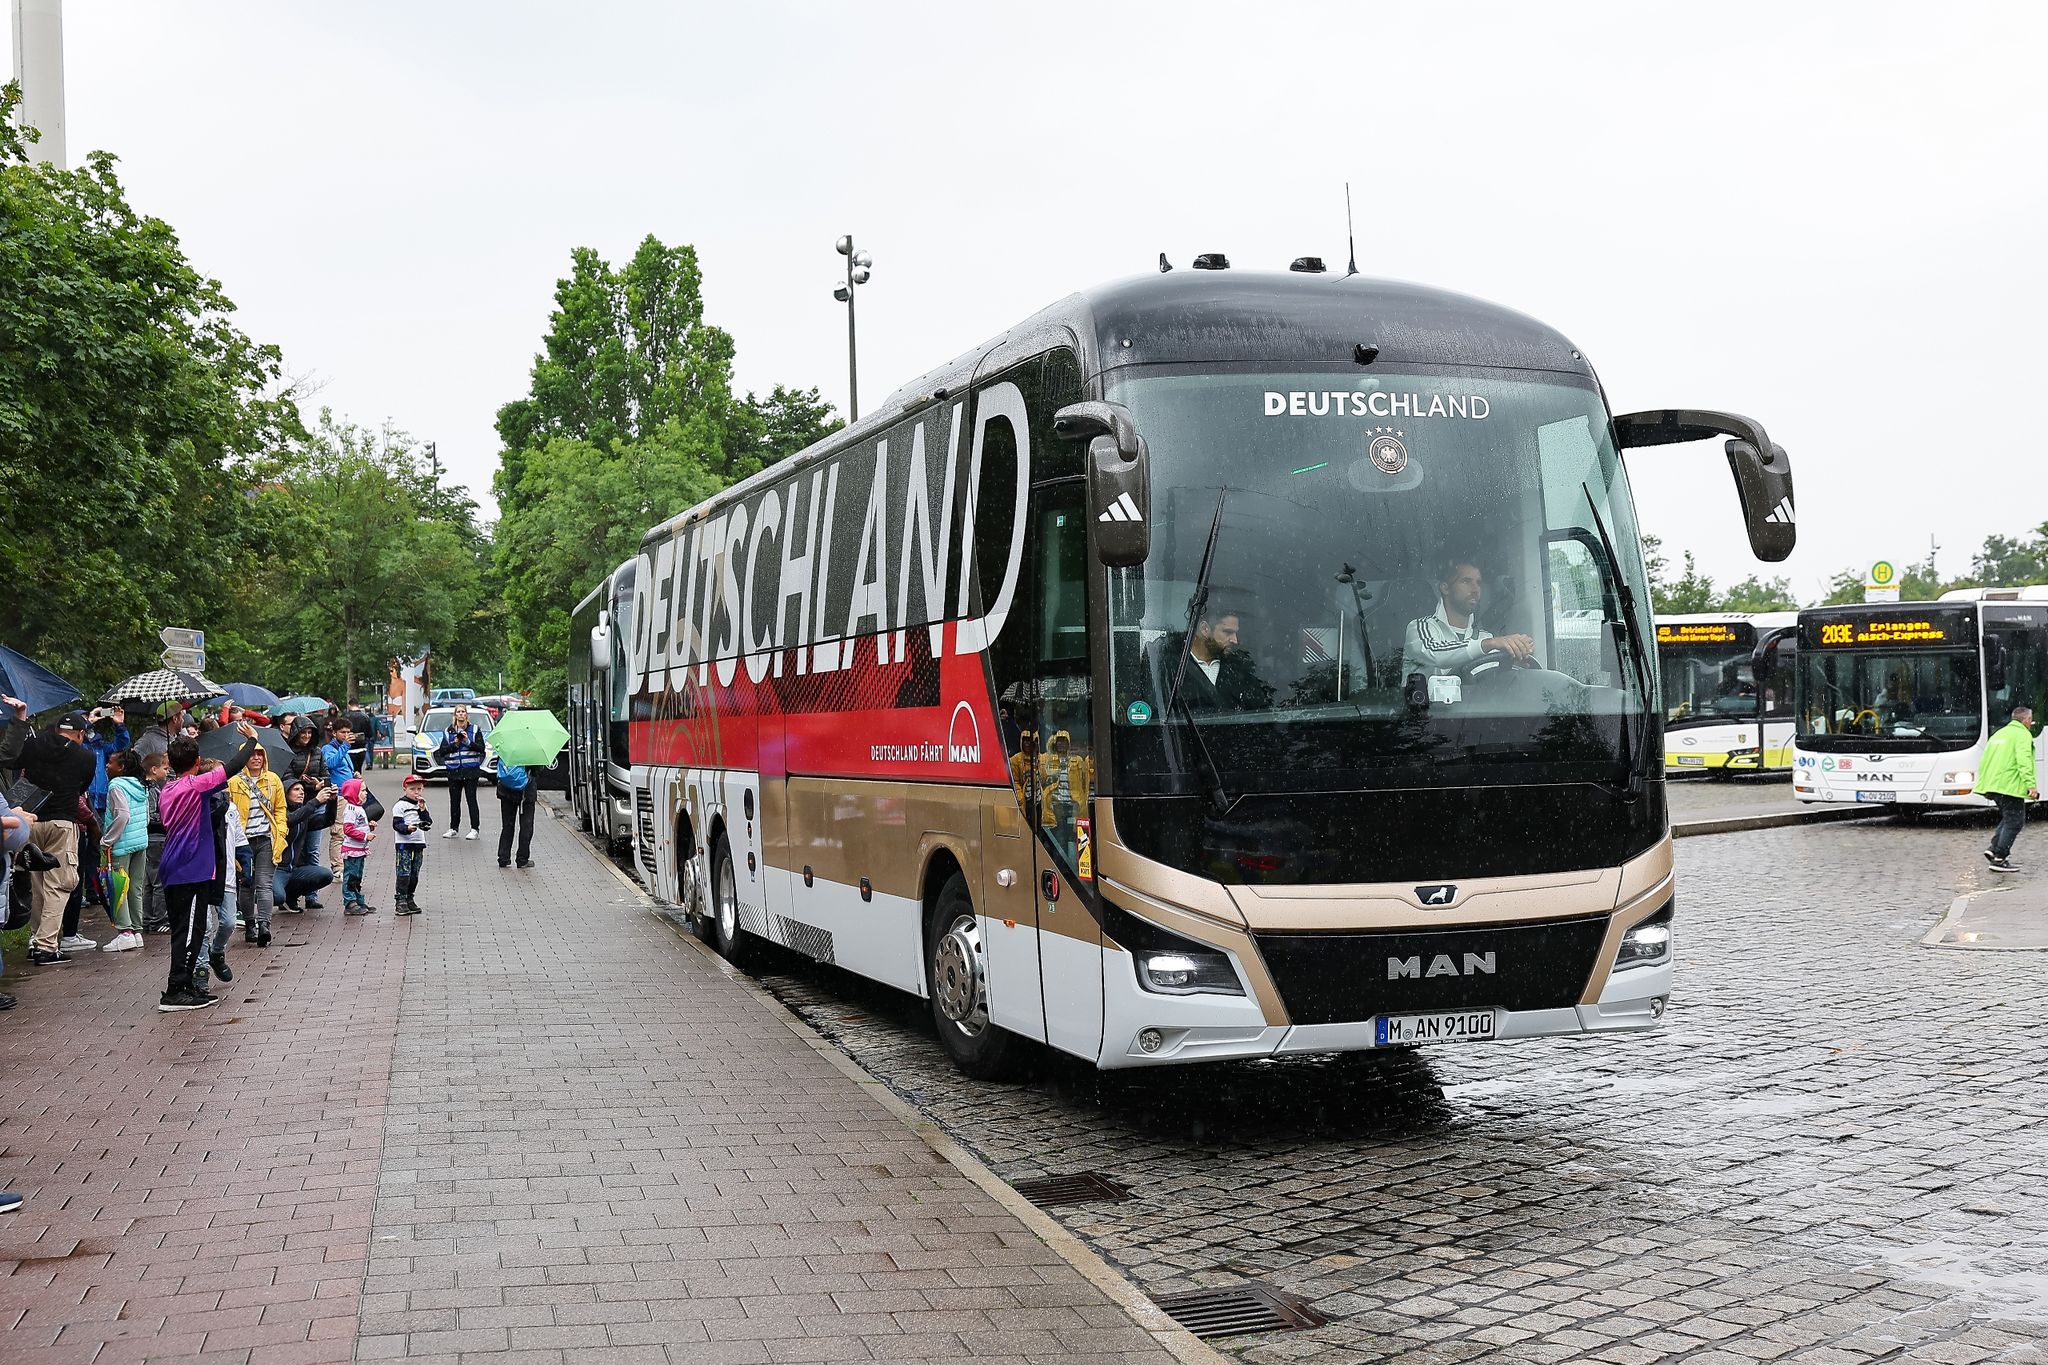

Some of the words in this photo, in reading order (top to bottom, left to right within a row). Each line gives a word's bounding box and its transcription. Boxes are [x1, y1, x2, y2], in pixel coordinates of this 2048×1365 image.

[1263, 391, 1491, 419] DEUTSCHLAND
[629, 381, 1030, 695] DEUTSCHLAND
[1821, 624, 1854, 644] 203E
[1857, 631, 1945, 641] Aisch-Express
[1869, 622, 1931, 632] Erlangen
[871, 745, 919, 762] DEUTSCHLAND
[920, 740, 944, 762] FÄHRT
[949, 745, 979, 763] MAN
[1839, 759, 1853, 769] DB
[1857, 773, 1894, 782] MAN
[1387, 951, 1496, 980] MAN
[1389, 1020, 1402, 1040] M
[1415, 1017, 1440, 1038] AN
[1444, 1014, 1492, 1036] 9100
